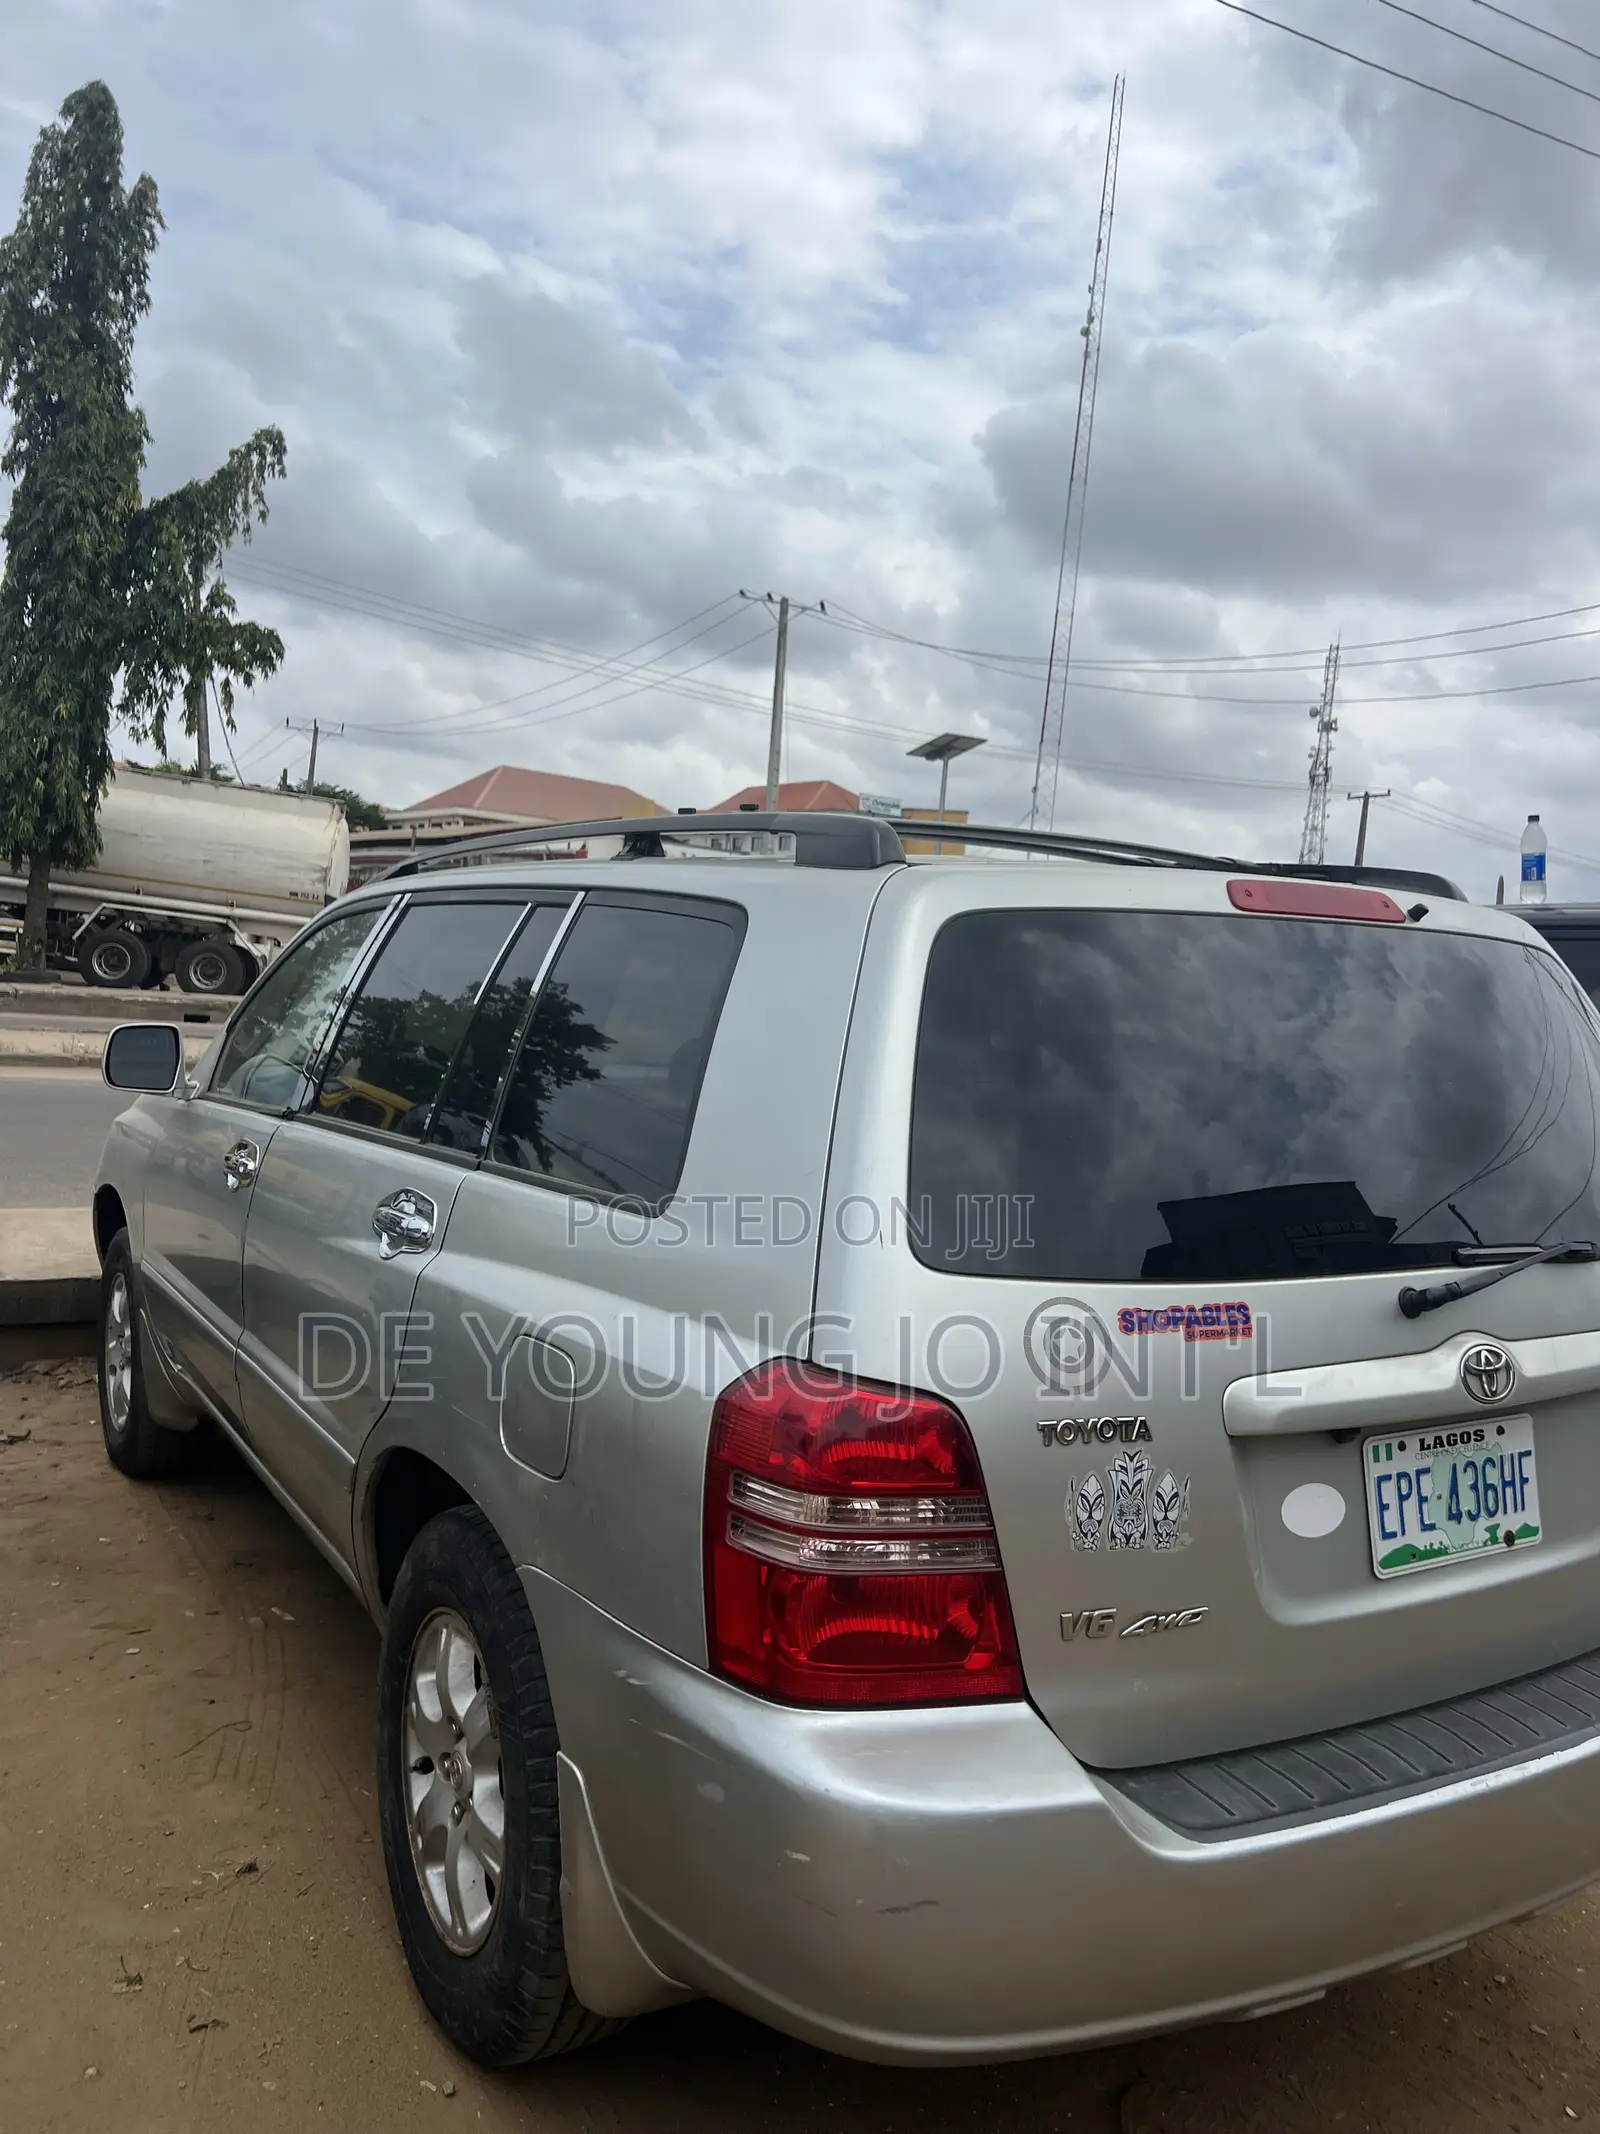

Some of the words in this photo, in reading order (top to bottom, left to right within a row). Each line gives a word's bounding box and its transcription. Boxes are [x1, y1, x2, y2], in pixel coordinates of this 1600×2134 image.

[1120, 1303, 1251, 1333] SHOPABLES
[1187, 1326, 1252, 1340] SUPERMARKET
[1037, 1416, 1153, 1446] TOYOTA
[1418, 1429, 1485, 1451] LAGOS
[1414, 1450, 1440, 1461] CENTRE
[1060, 1607, 1117, 1641] V6
[1119, 1605, 1209, 1638] 4WD
